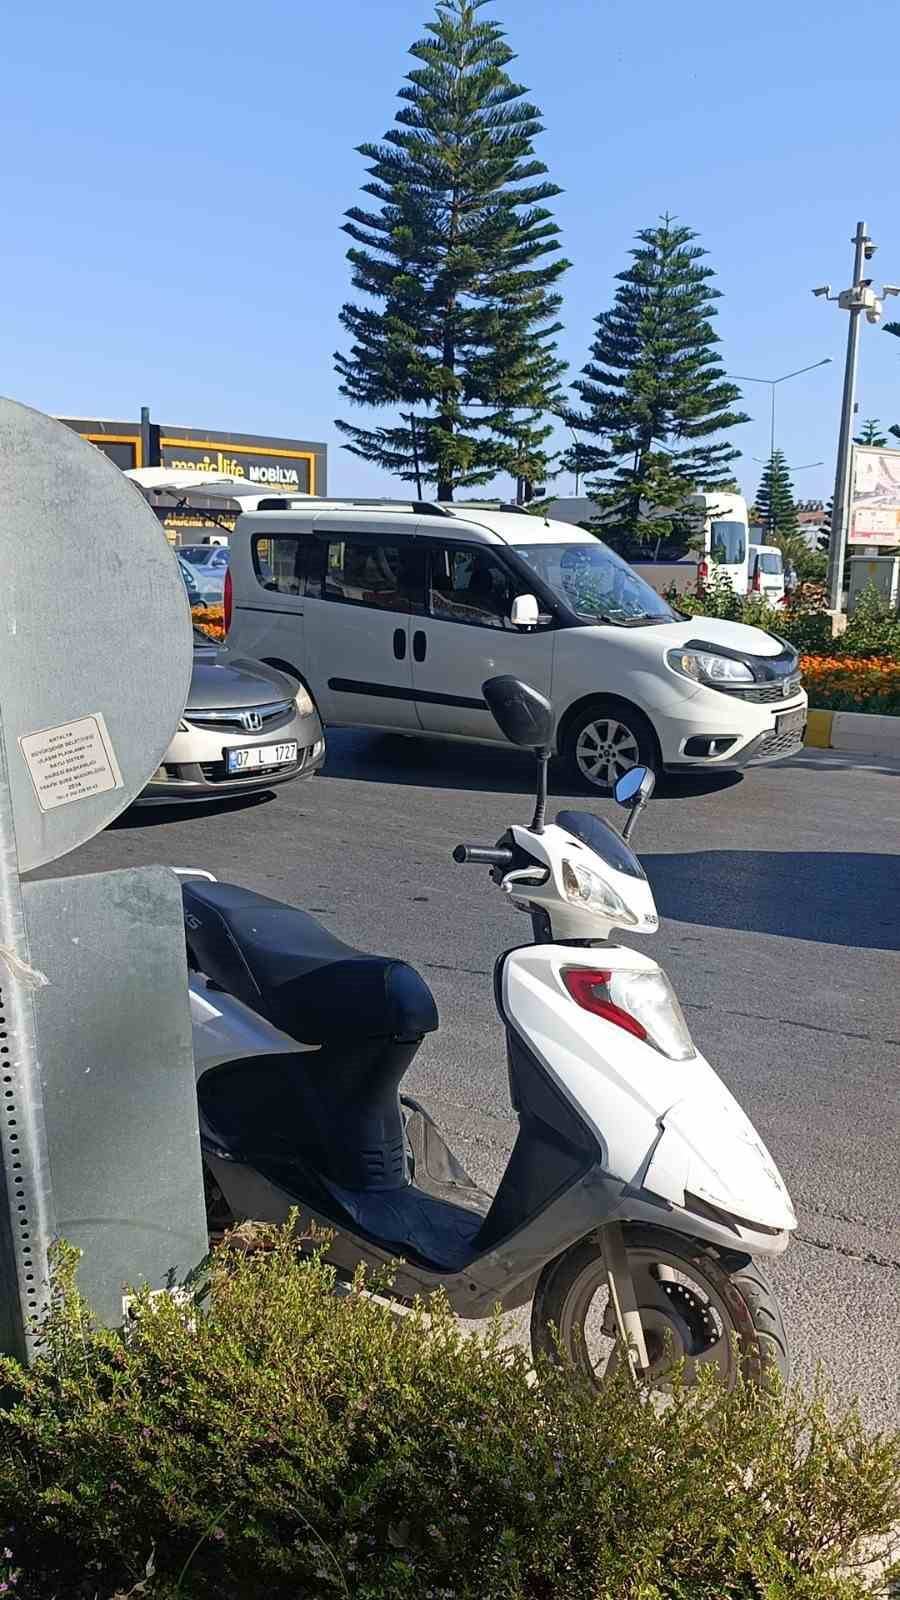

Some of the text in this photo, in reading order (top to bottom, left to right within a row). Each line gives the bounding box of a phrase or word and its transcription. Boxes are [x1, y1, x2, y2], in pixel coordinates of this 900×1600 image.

[249, 465, 299, 484] MOBİLYA
[237, 751, 249, 766] 07
[258, 749, 265, 764] L
[275, 744, 296, 761] 1727
